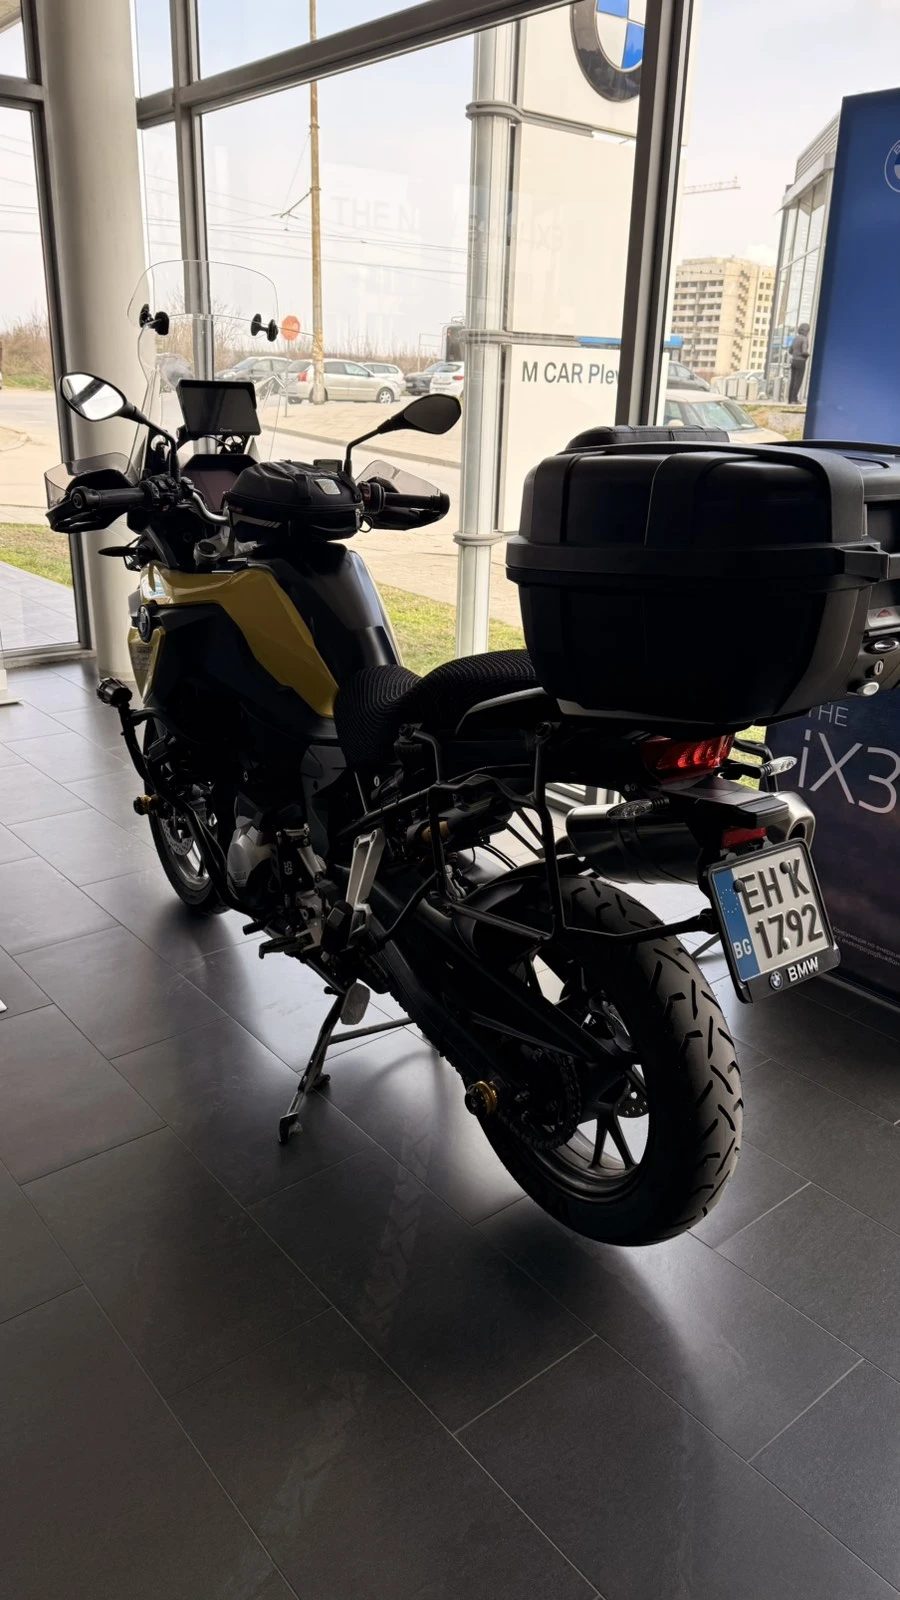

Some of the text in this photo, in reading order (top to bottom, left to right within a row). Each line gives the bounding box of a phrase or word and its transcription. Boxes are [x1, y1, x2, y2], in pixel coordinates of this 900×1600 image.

[521, 360, 538, 383] M
[543, 361, 583, 384] CAR
[798, 729, 900, 814] iX3
[754, 901, 824, 959] 1792
[732, 938, 753, 960] BG
[787, 956, 819, 982] BMW
